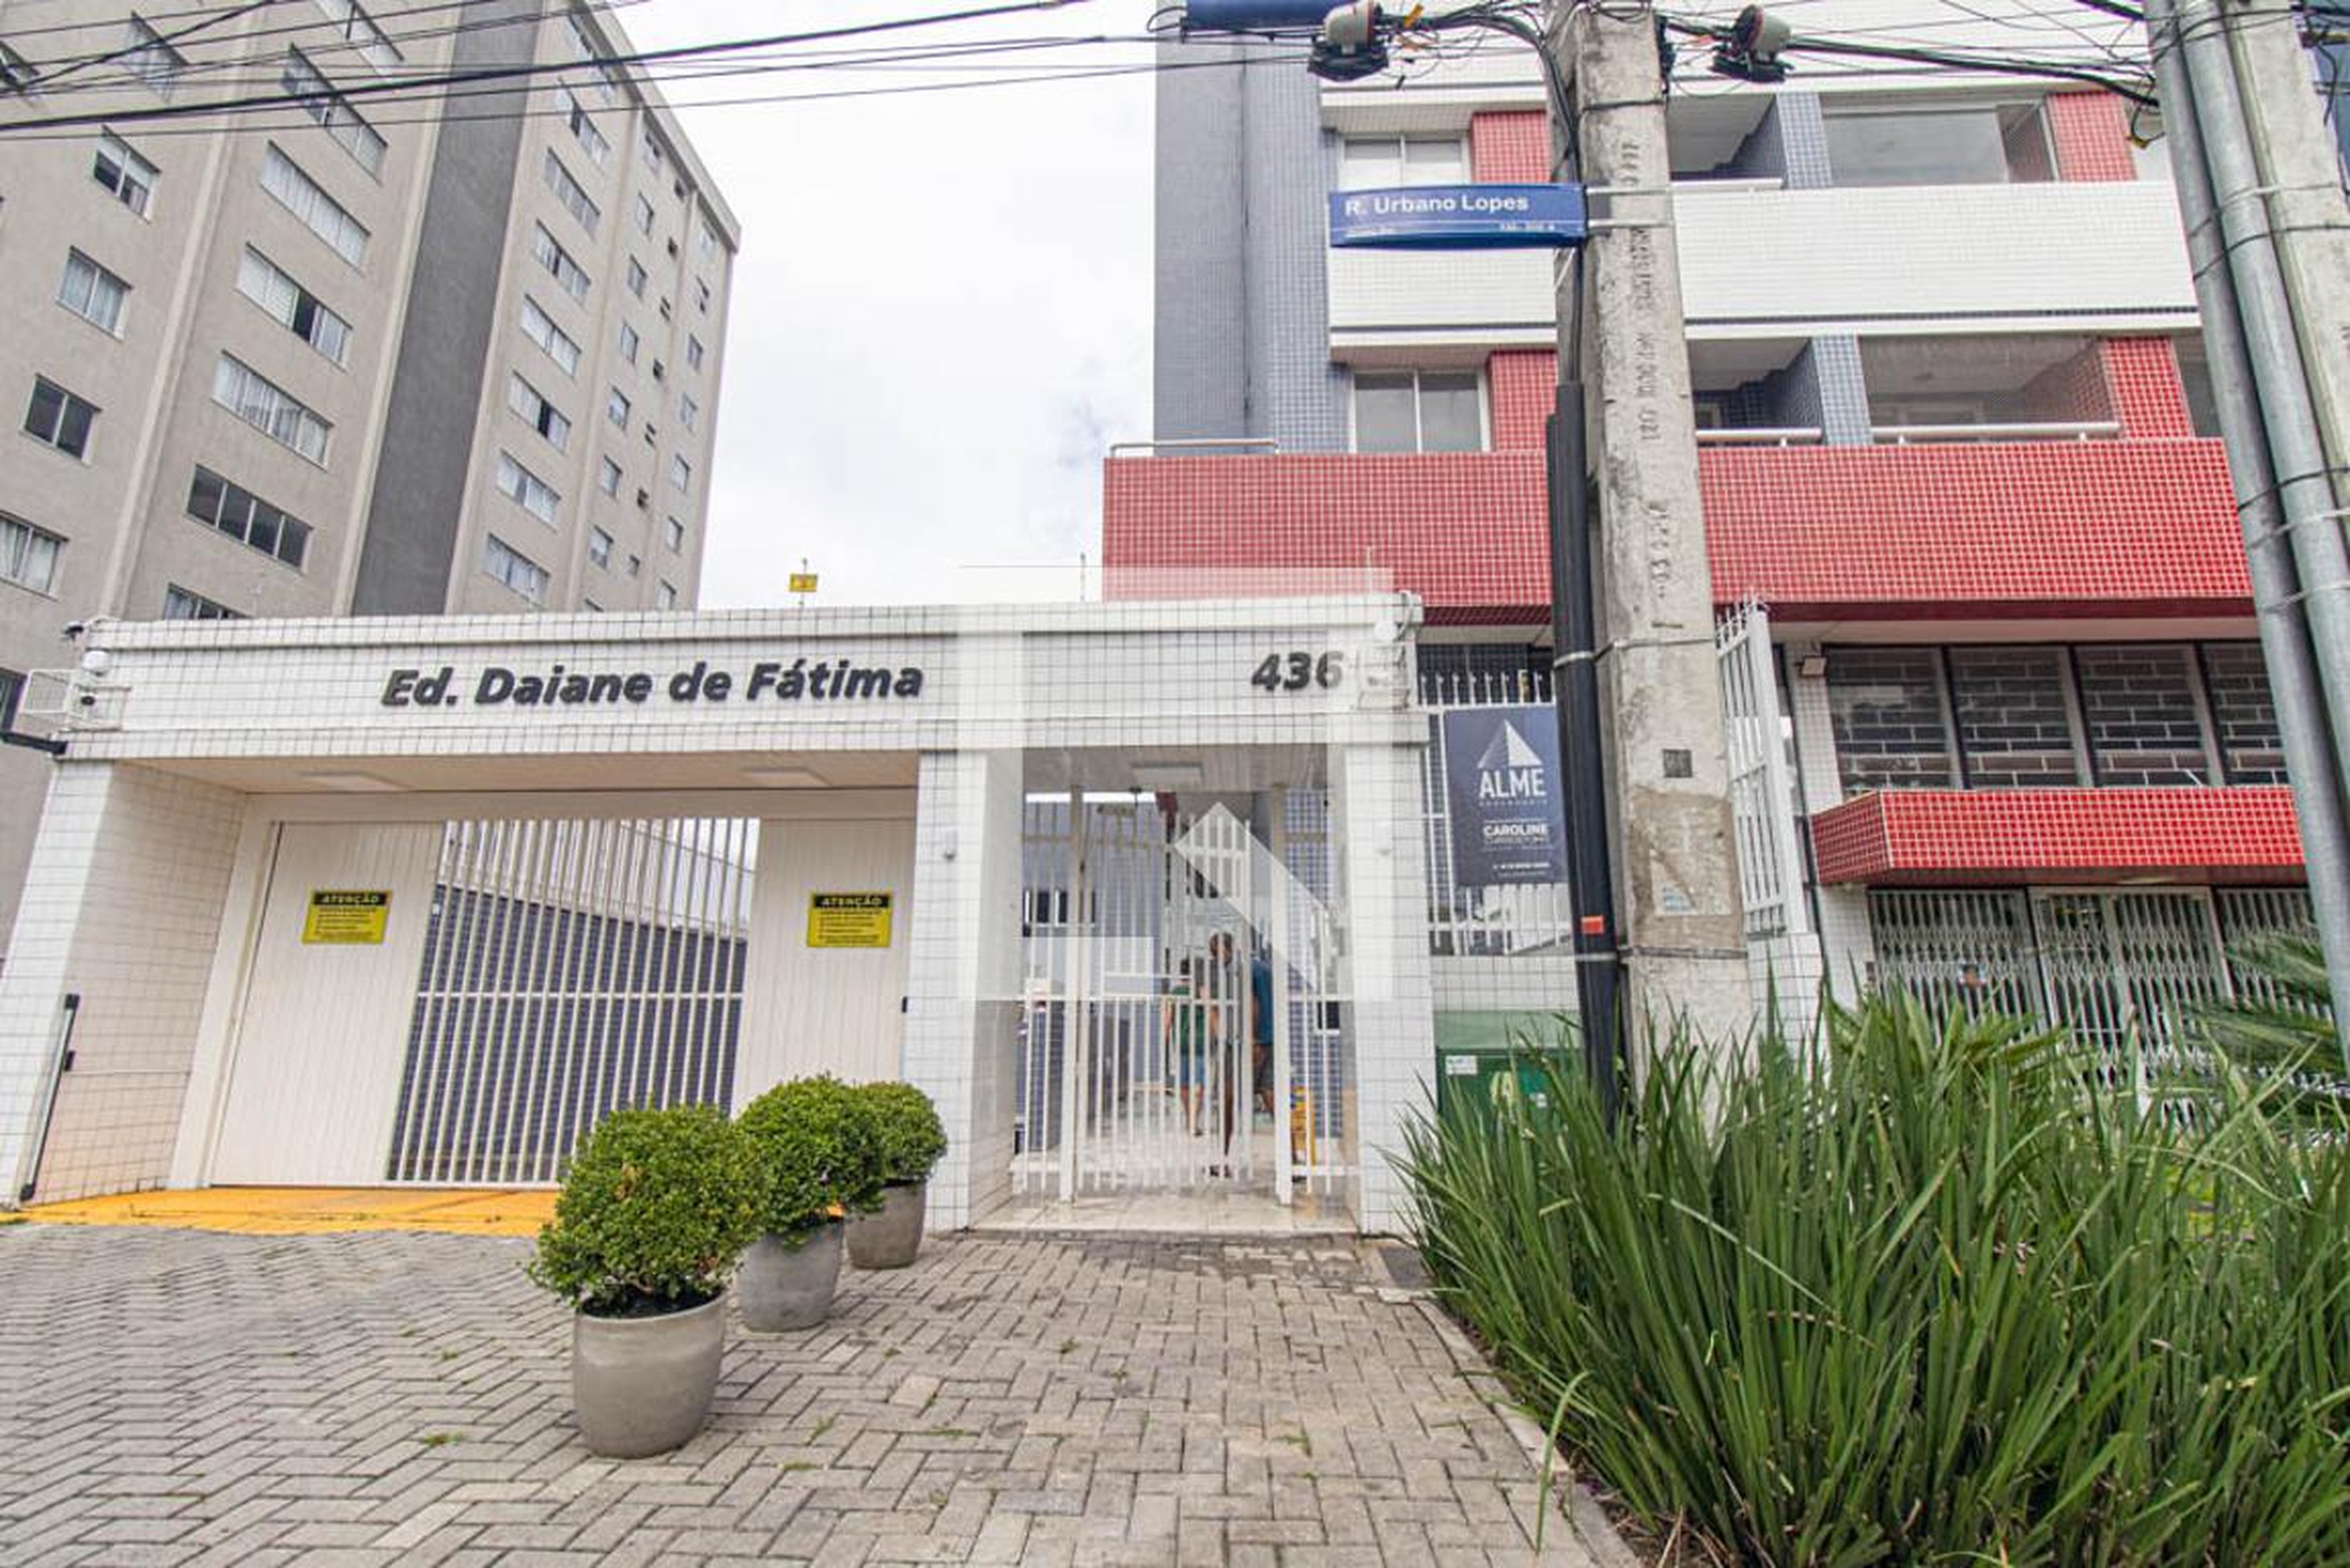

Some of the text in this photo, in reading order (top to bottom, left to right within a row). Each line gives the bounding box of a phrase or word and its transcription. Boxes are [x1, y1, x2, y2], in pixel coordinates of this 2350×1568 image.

[1346, 193, 1529, 216] R. Urbano Lopes
[381, 659, 923, 706] Ed. Daiane de Fátima
[1251, 651, 1343, 691] 436
[1479, 768, 1547, 798] ALME
